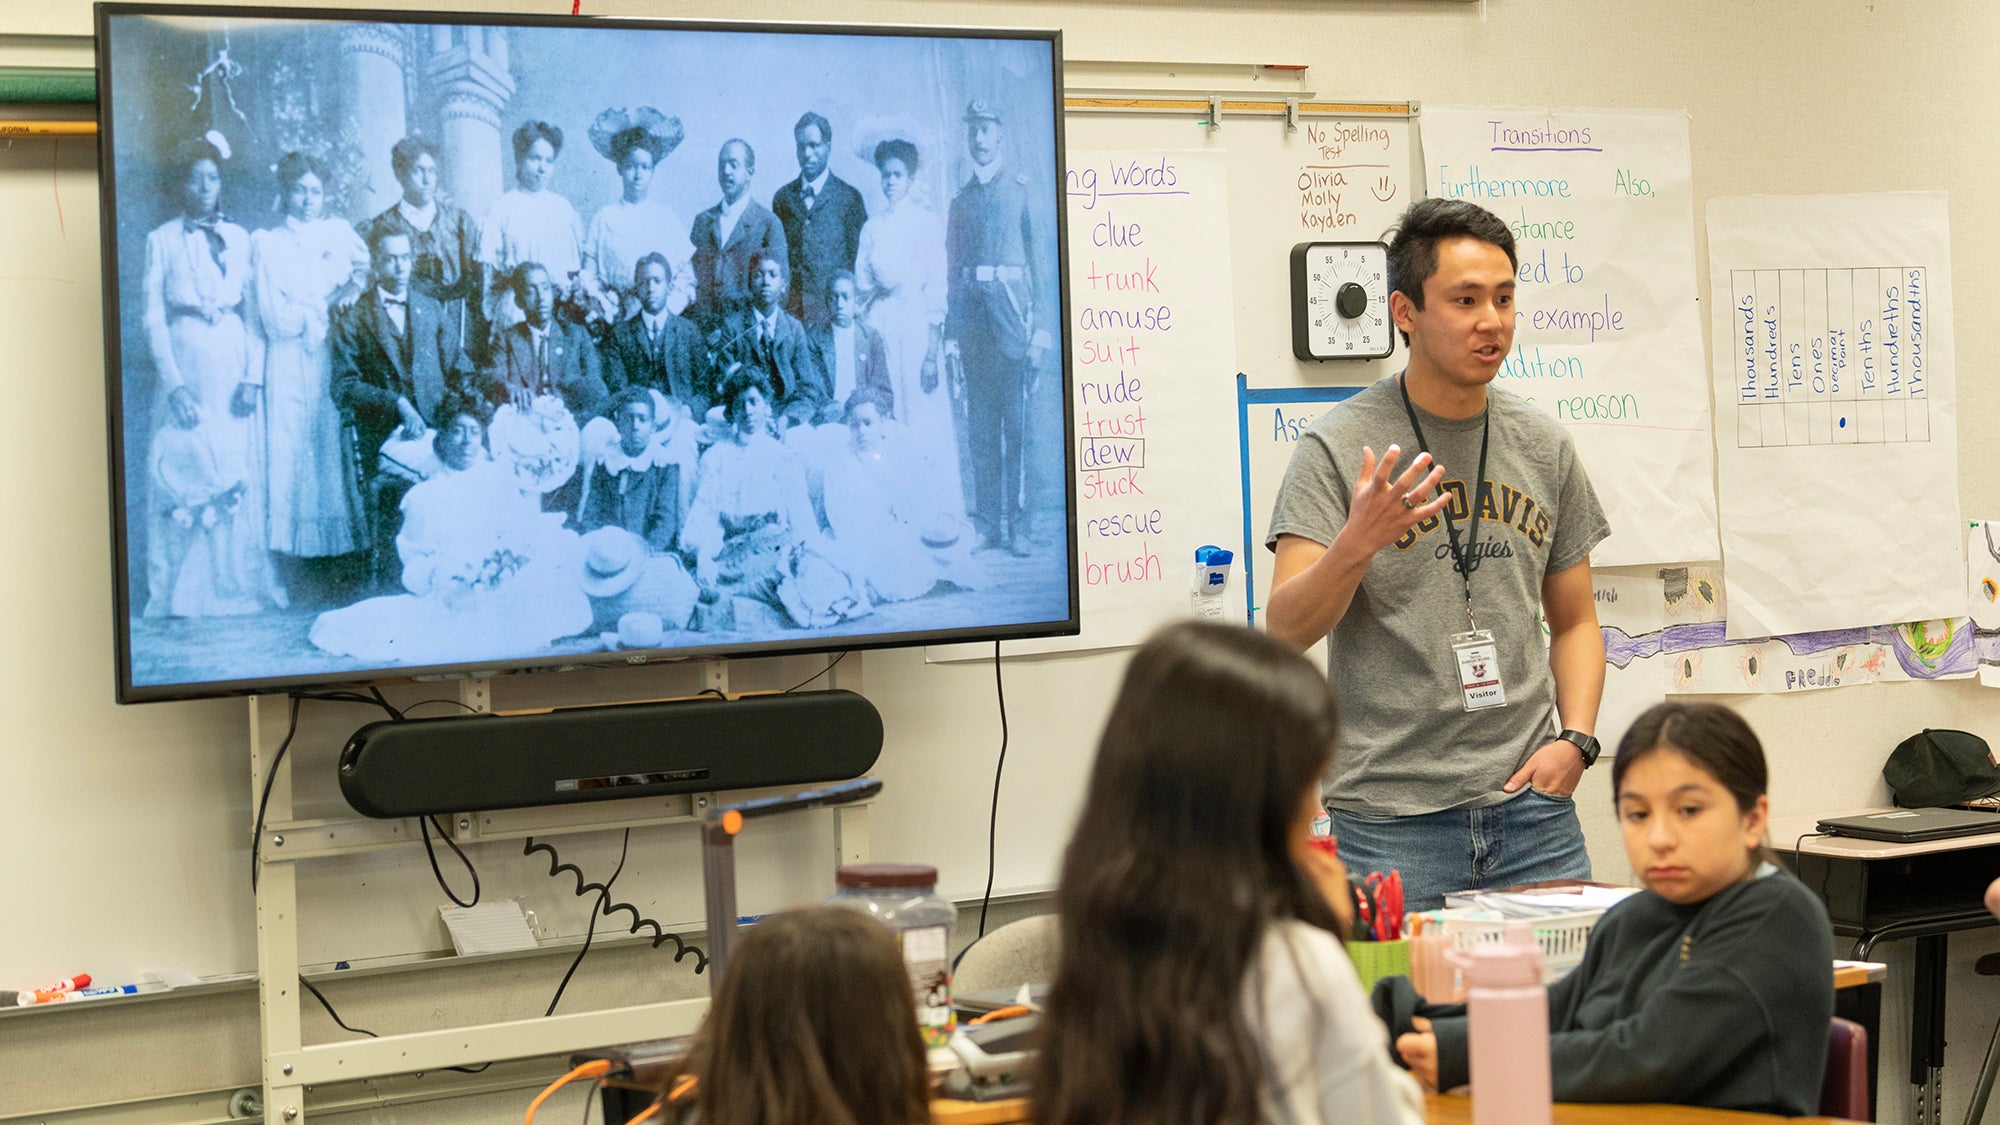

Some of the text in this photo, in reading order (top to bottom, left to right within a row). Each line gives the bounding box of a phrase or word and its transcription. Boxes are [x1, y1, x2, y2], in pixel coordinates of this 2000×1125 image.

[1307, 121, 1390, 150] No Spelling
[1488, 120, 1592, 145] Transitions
[1318, 146, 1343, 160] Test
[1109, 156, 1177, 187] Words
[1297, 171, 1348, 191] Olivia
[1440, 165, 1571, 199] Furthermore
[1614, 169, 1655, 198] Also,
[1301, 189, 1342, 213] Molly
[1092, 210, 1144, 247] clue
[1300, 208, 1357, 234] Kayden
[1325, 256, 1333, 264] 55
[1361, 255, 1365, 263] 5
[1561, 251, 1584, 284] to
[1088, 257, 1160, 293] trunk
[1313, 273, 1321, 281] 50
[1309, 297, 1318, 305] 45
[1378, 295, 1386, 303] 15
[1080, 305, 1172, 331] amuse
[1314, 319, 1322, 327] 40
[1374, 318, 1382, 326] 20
[1533, 293, 1624, 342] example
[1328, 336, 1336, 344] 35
[1345, 342, 1353, 350] 30
[1738, 294, 1757, 402] Thousands
[1882, 285, 1902, 395] Hundreths
[1907, 269, 1925, 398] Thousandths
[1079, 335, 1141, 366] suit
[1764, 304, 1780, 399] Hundreds
[1858, 319, 1876, 394] Tenths
[1788, 343, 1803, 393] Tens
[1811, 337, 1826, 394] Ones
[1080, 370, 1143, 405] rude
[1082, 405, 1147, 436] trust
[1557, 393, 1640, 420] reason
[1083, 437, 1135, 468] dew
[1086, 509, 1163, 538] rescue
[1441, 479, 1550, 549] DAVIS
[1085, 541, 1162, 586] brush
[1469, 690, 1497, 699] Visitor
